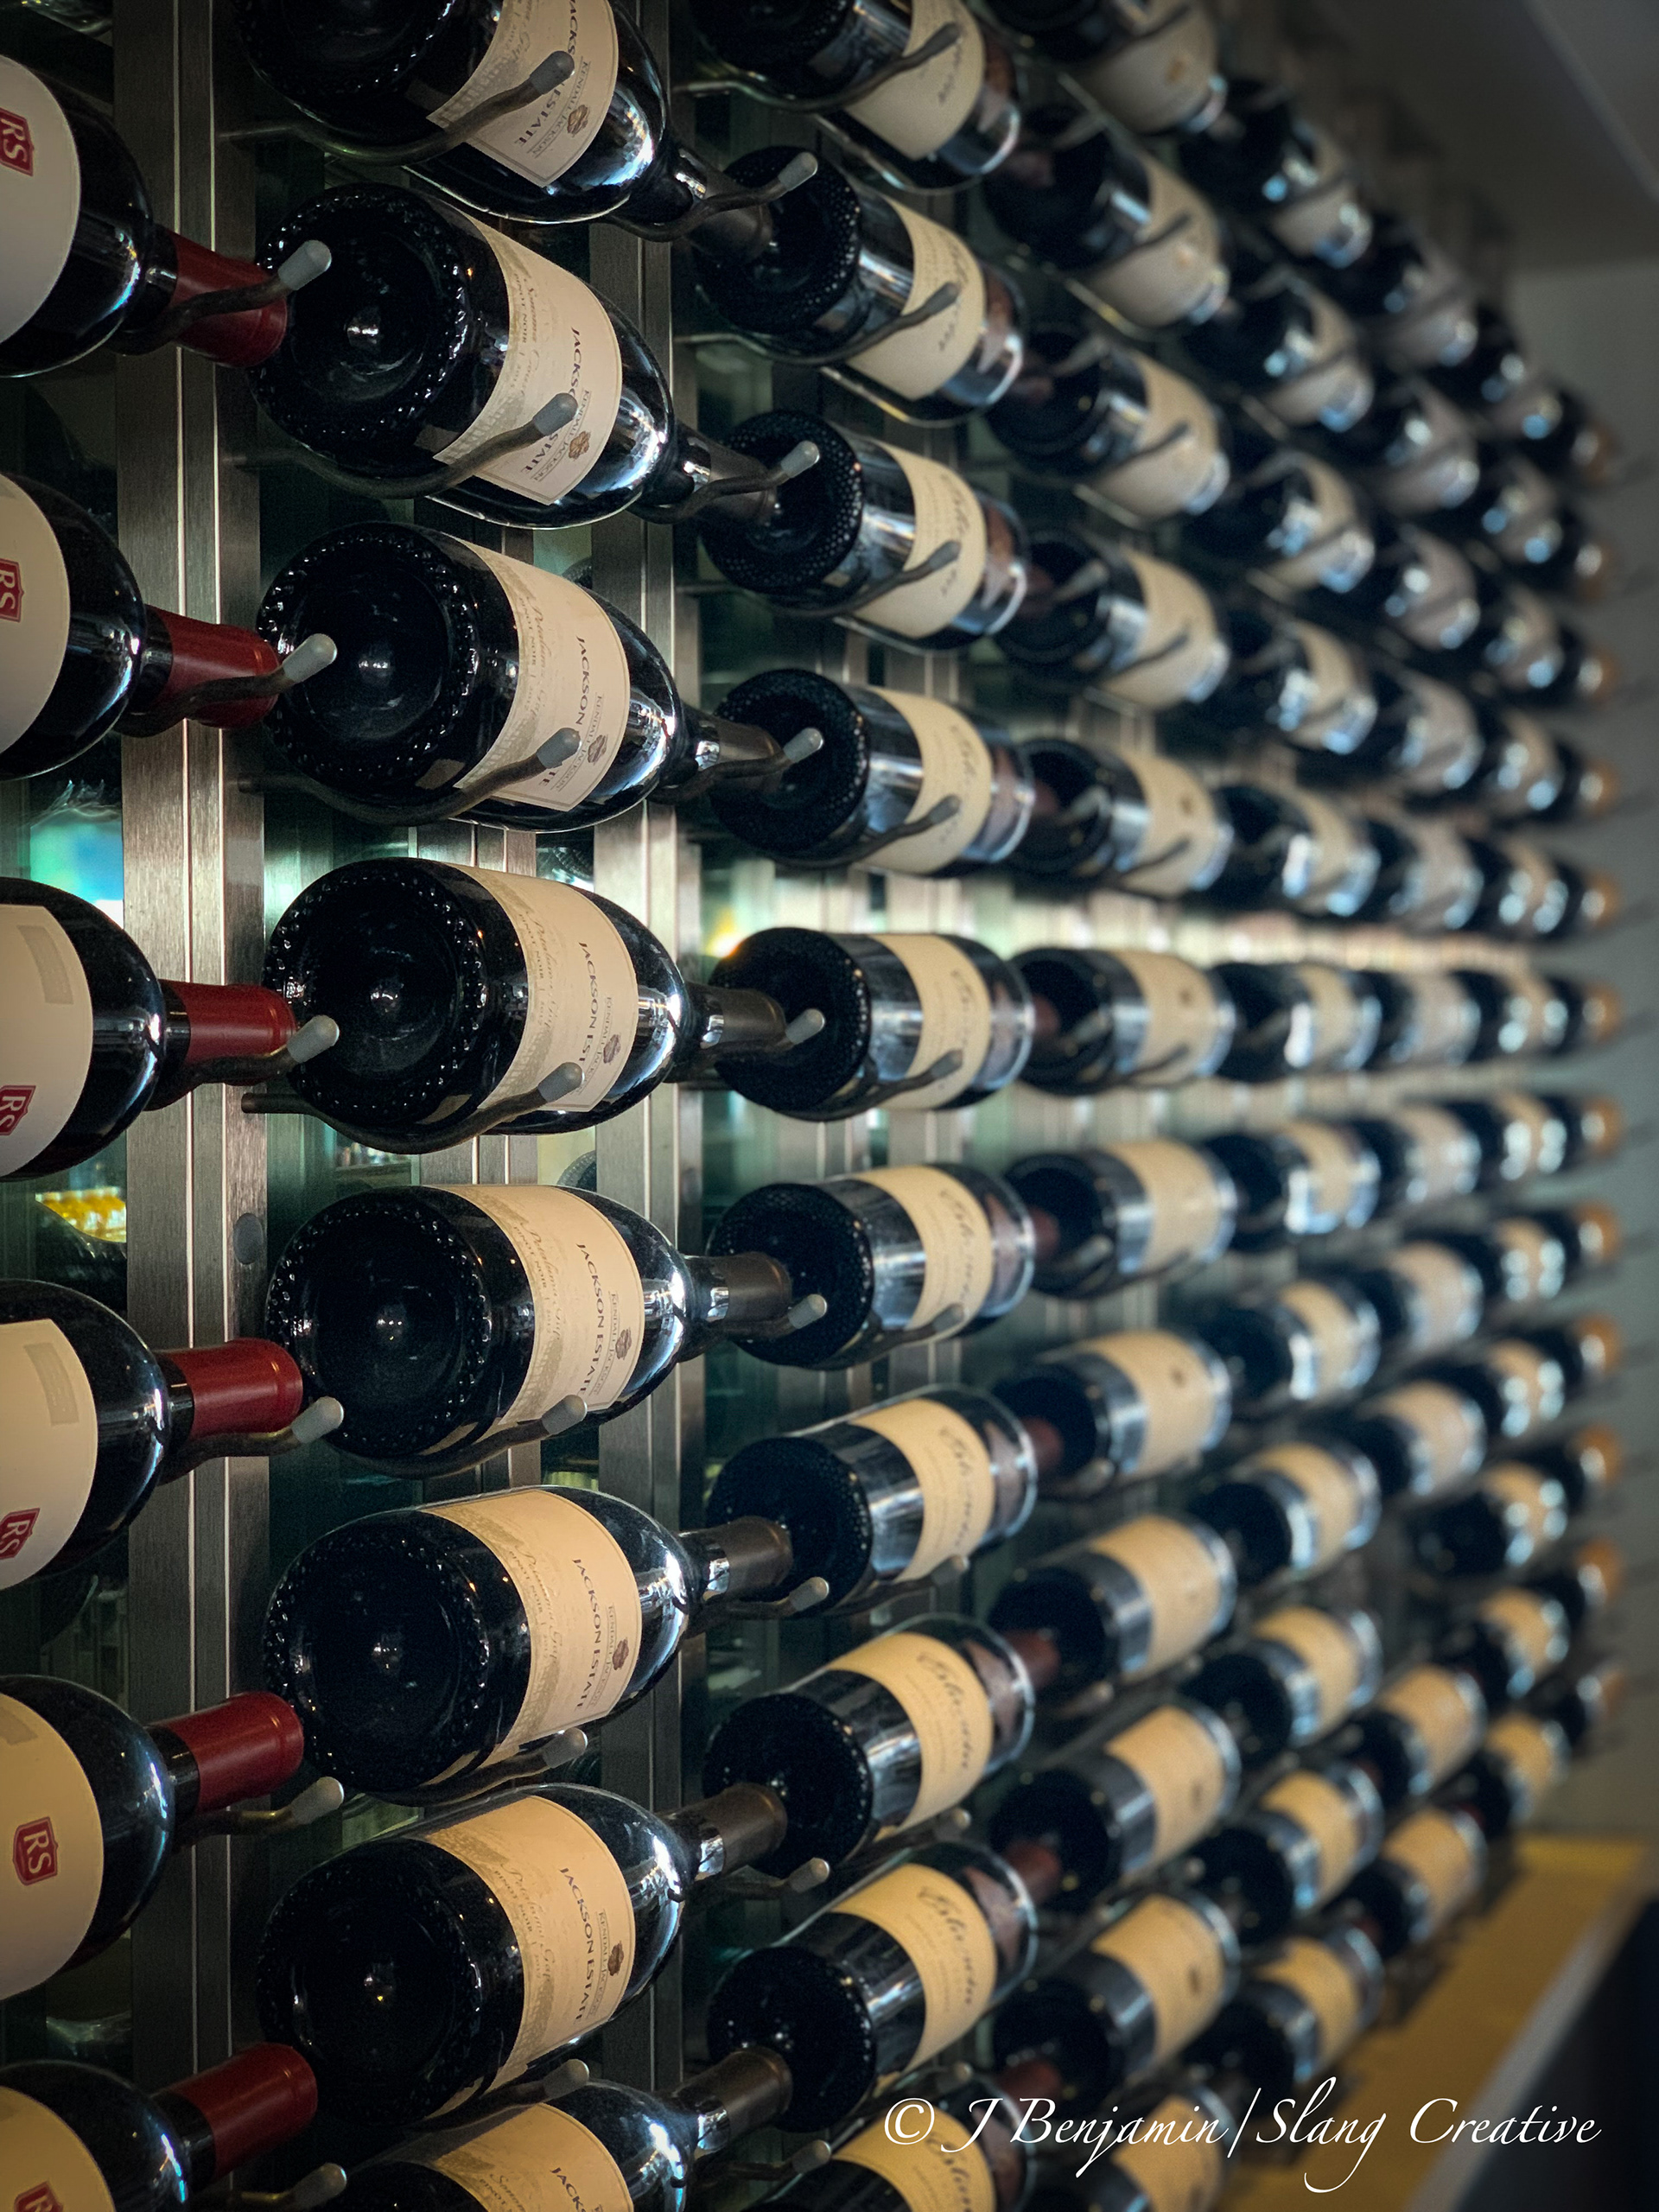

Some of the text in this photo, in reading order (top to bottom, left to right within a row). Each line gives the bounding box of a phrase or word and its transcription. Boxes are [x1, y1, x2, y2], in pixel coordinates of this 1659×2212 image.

[1, 119, 28, 162] RS
[514, 88, 562, 146] ESTATE
[514, 273, 526, 310] PINOT
[520, 326, 582, 472] JACKS STATE
[519, 597, 533, 630] PINOT
[575, 634, 590, 725] JACKSON
[518, 913, 537, 944] PINOT
[535, 950, 543, 979] NOIR
[578, 942, 599, 1063] JACKSON EST
[514, 1227, 535, 1255] PINOT
[535, 1261, 547, 1287] NOIR
[575, 1242, 604, 1396] JACKSON ESTATE
[509, 1550, 531, 1580] PINOT
[531, 1586, 543, 1613] NOIR
[549, 1630, 563, 1663] Gap
[572, 1559, 601, 1712] JACKSON ESTATE
[23, 1830, 52, 1873] RS
[494, 1870, 518, 1899] PINOT
[518, 1904, 534, 1933] NOIR
[542, 1948, 556, 1983] Gap
[558, 1867, 595, 2026] JACKSON ESTATE
[479, 2178, 506, 2205] PINOT
[550, 2167, 586, 2212] JACK
